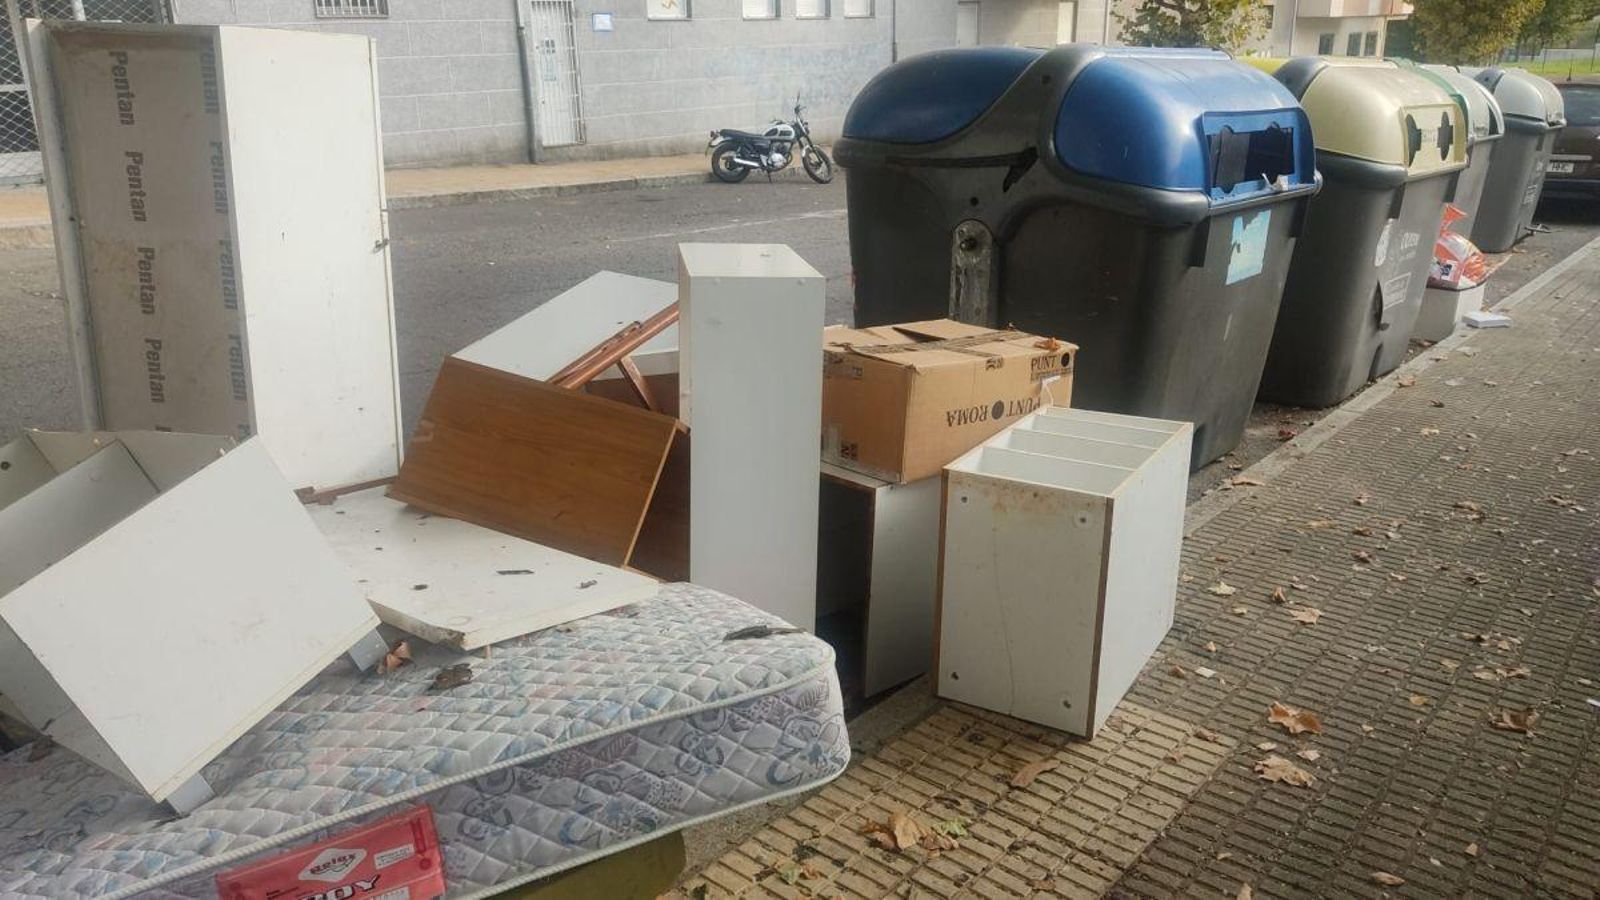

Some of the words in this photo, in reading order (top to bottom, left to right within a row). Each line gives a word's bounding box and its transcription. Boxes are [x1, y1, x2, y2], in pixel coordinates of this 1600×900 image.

[111, 50, 136, 126] Pentan
[127, 151, 149, 223] Pentan
[139, 247, 157, 315] Pentan
[148, 338, 165, 403] Pentan
[1031, 354, 1058, 371] PUNT
[946, 404, 989, 428] ROMA
[1006, 396, 1041, 418] PUNT
